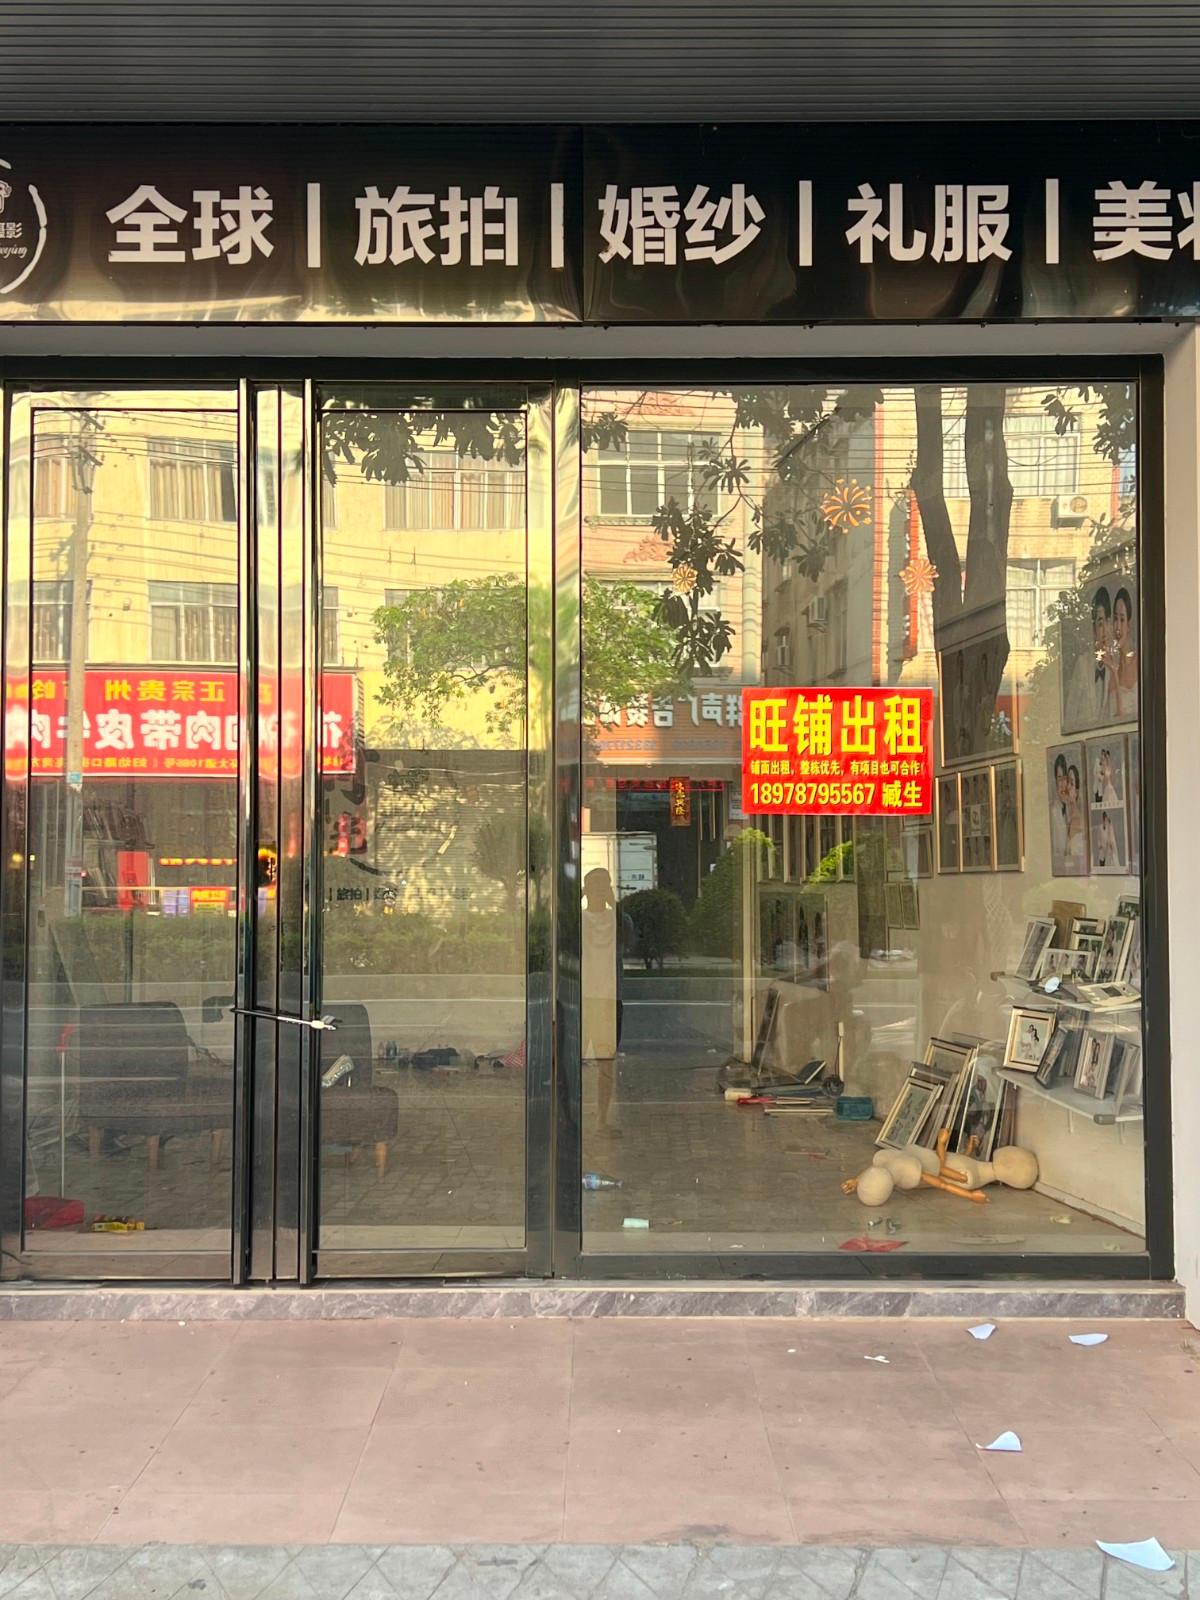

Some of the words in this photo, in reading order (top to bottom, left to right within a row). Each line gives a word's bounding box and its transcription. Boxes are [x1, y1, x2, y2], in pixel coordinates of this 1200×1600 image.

[106, 185, 274, 265] 全球
[355, 185, 518, 266] 旅拍
[599, 183, 766, 266] 婚纱
[846, 182, 1013, 264] 礼服
[749, 694, 924, 755] 旺铺出租
[750, 783, 875, 805] 18978795567
